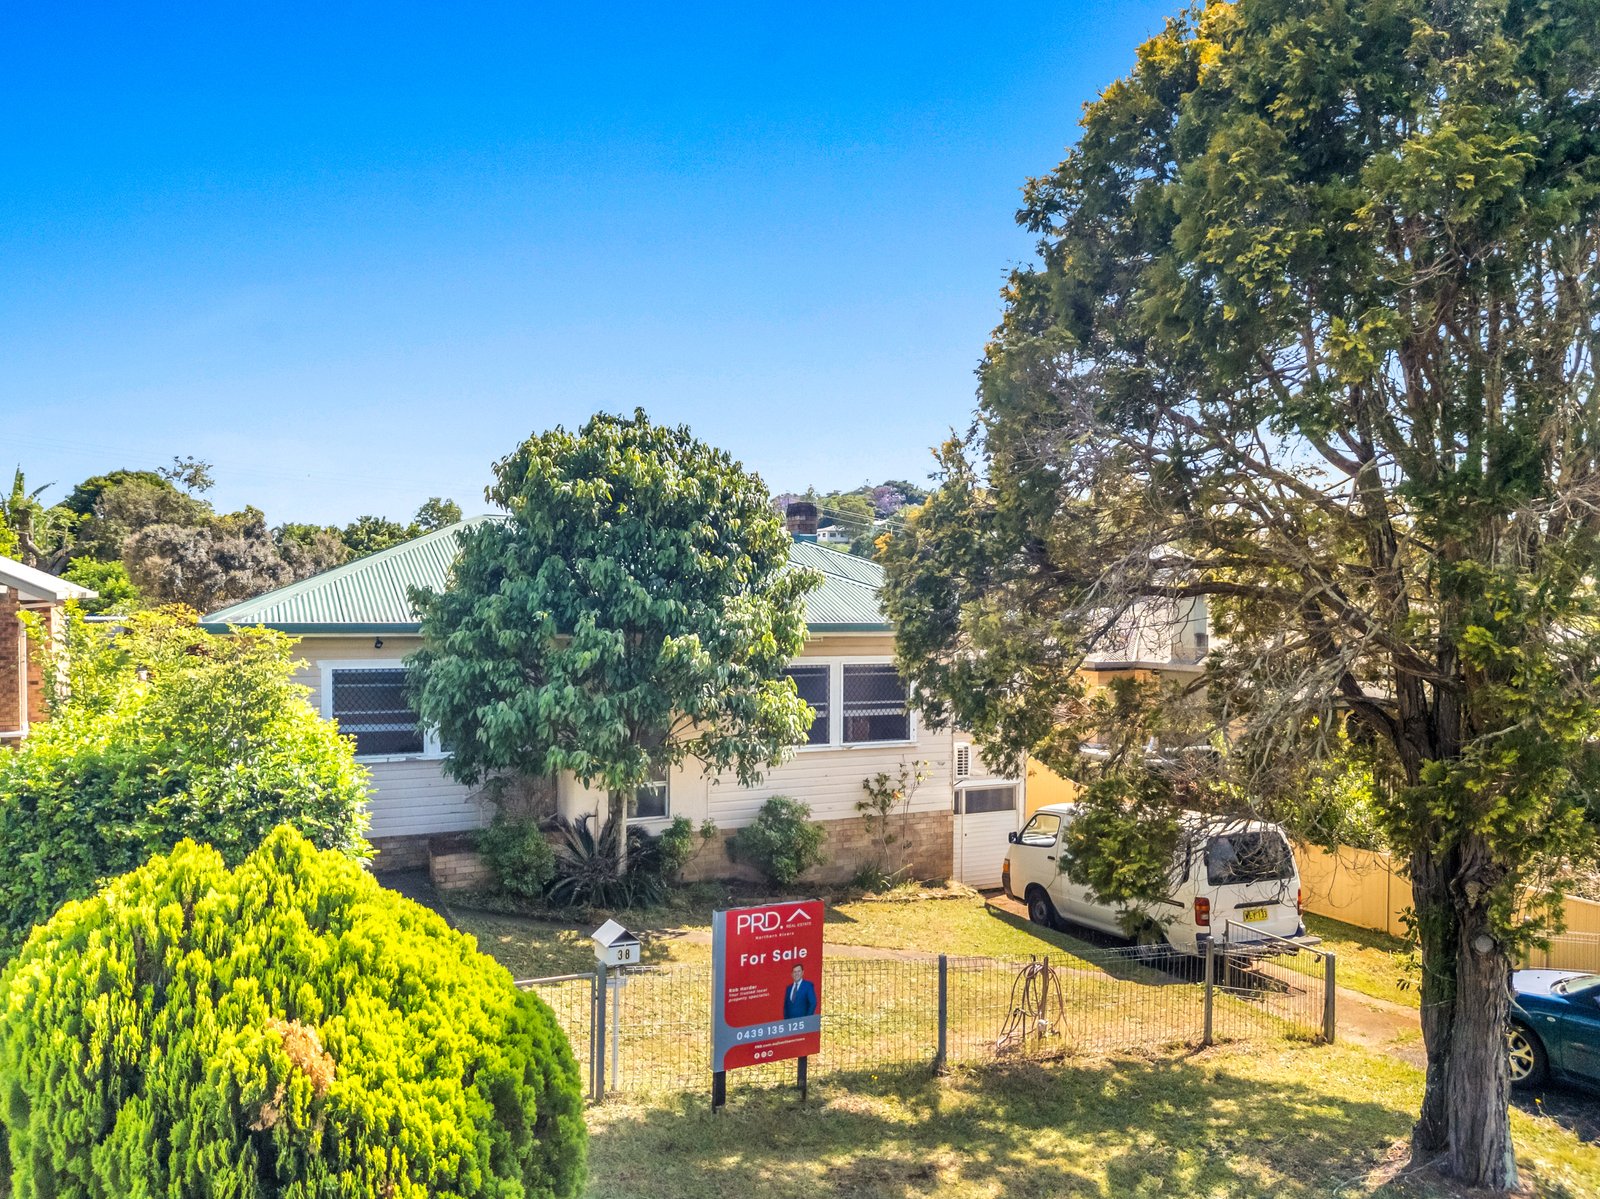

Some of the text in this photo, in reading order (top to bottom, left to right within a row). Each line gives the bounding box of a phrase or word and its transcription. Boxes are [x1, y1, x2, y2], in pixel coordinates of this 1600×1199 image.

[618, 949, 630, 960] 38
[740, 946, 808, 966] For Sale
[736, 1020, 805, 1041] 0439 135 125
